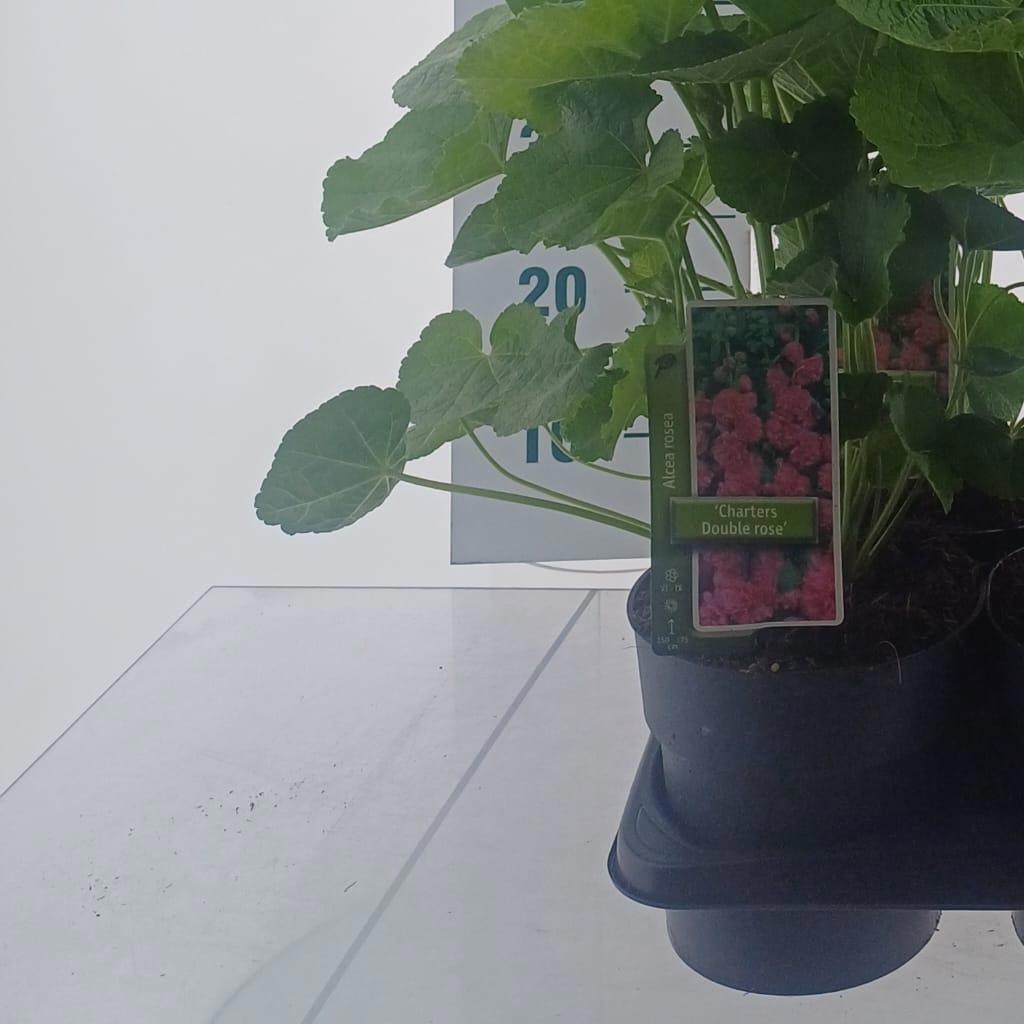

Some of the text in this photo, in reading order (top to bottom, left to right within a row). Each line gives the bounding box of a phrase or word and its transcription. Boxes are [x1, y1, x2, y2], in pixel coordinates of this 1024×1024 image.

[662, 412, 676, 489] Alcea rosea
[702, 521, 750, 536] Double
